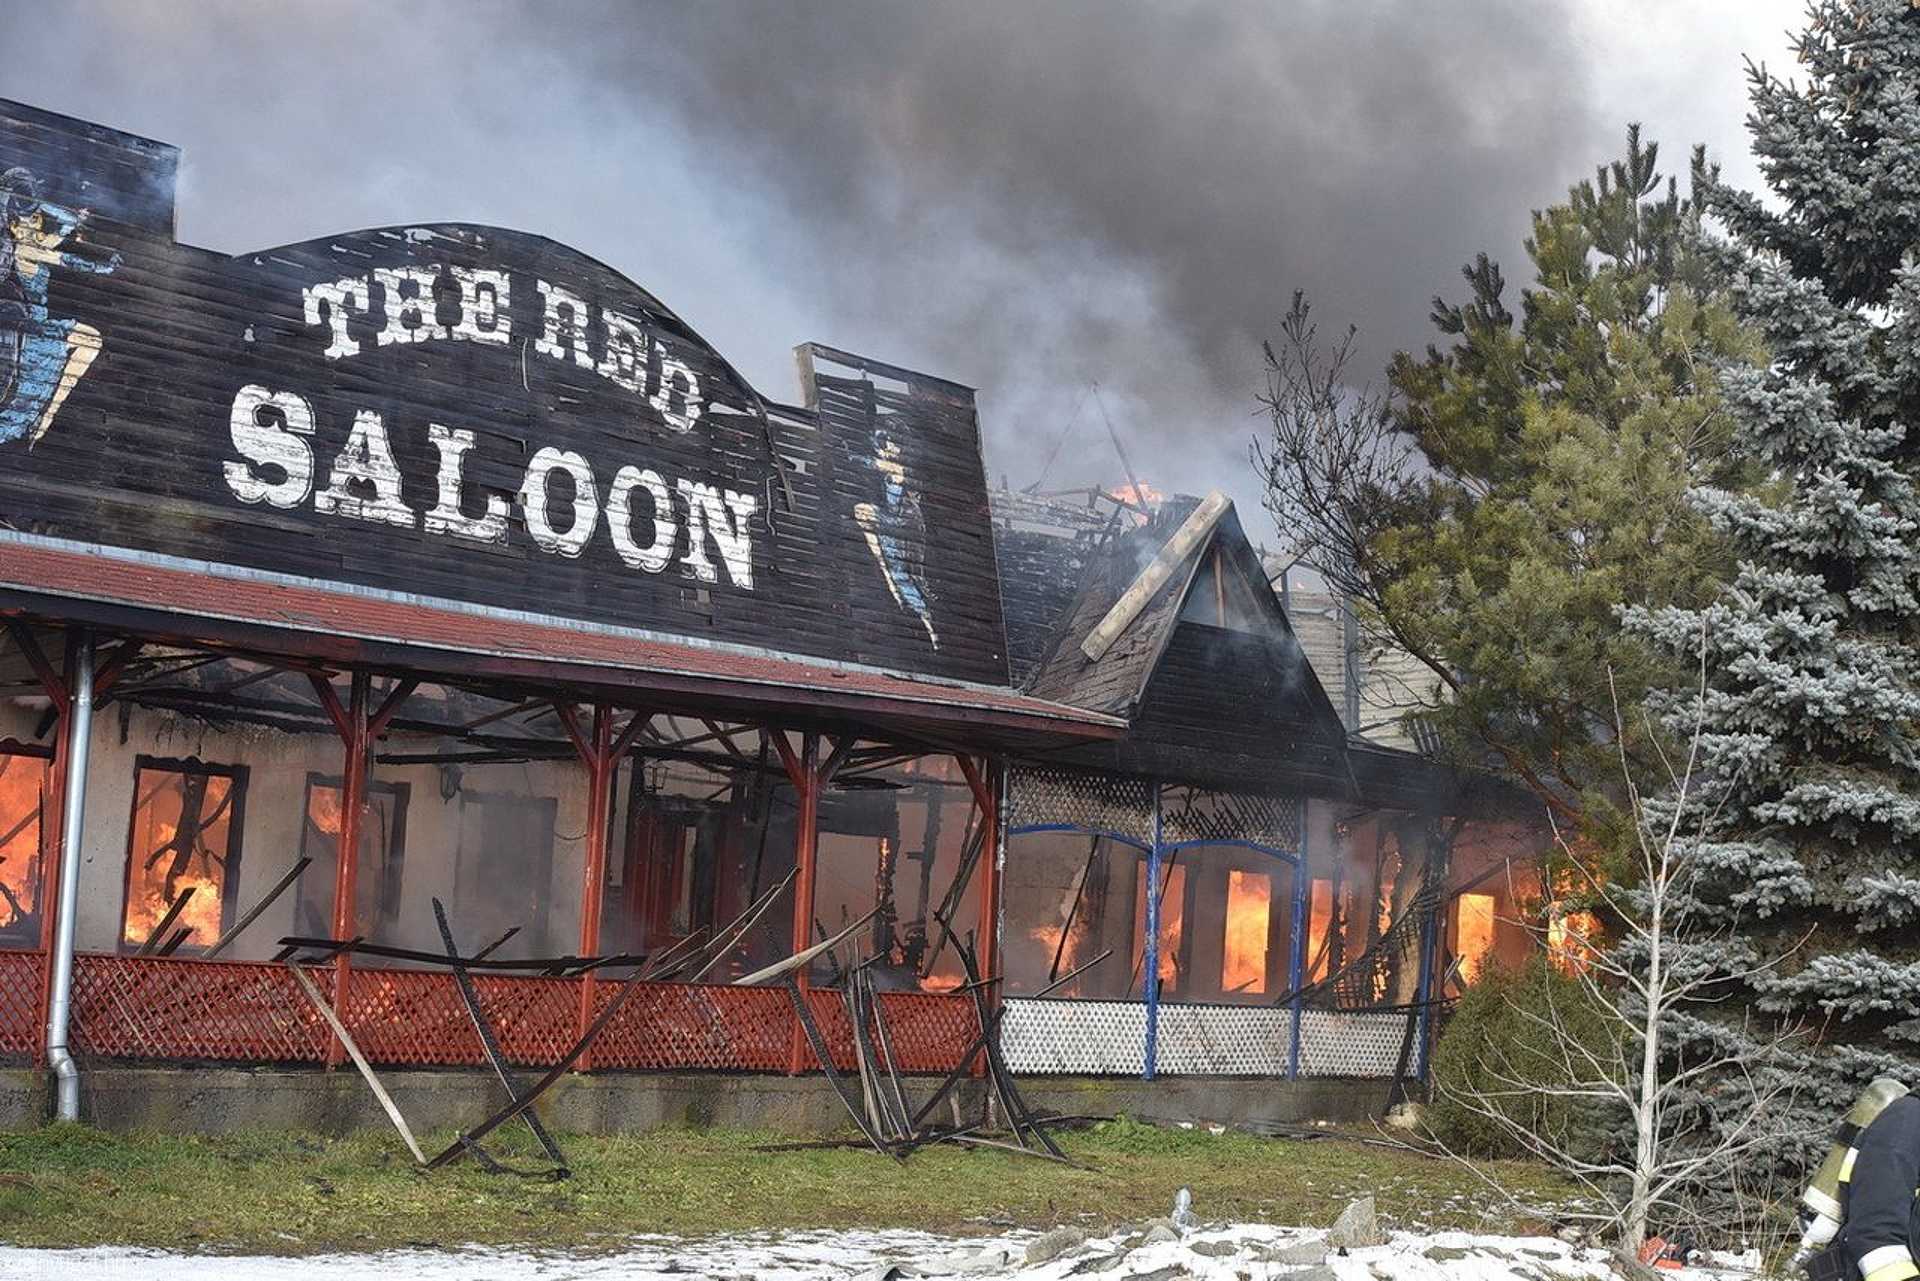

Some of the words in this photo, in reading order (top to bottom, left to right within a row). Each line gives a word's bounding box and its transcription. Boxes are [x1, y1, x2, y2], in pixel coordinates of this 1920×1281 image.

[302, 264, 511, 360] THE
[535, 278, 703, 434] RED
[222, 383, 760, 590] SALOON
